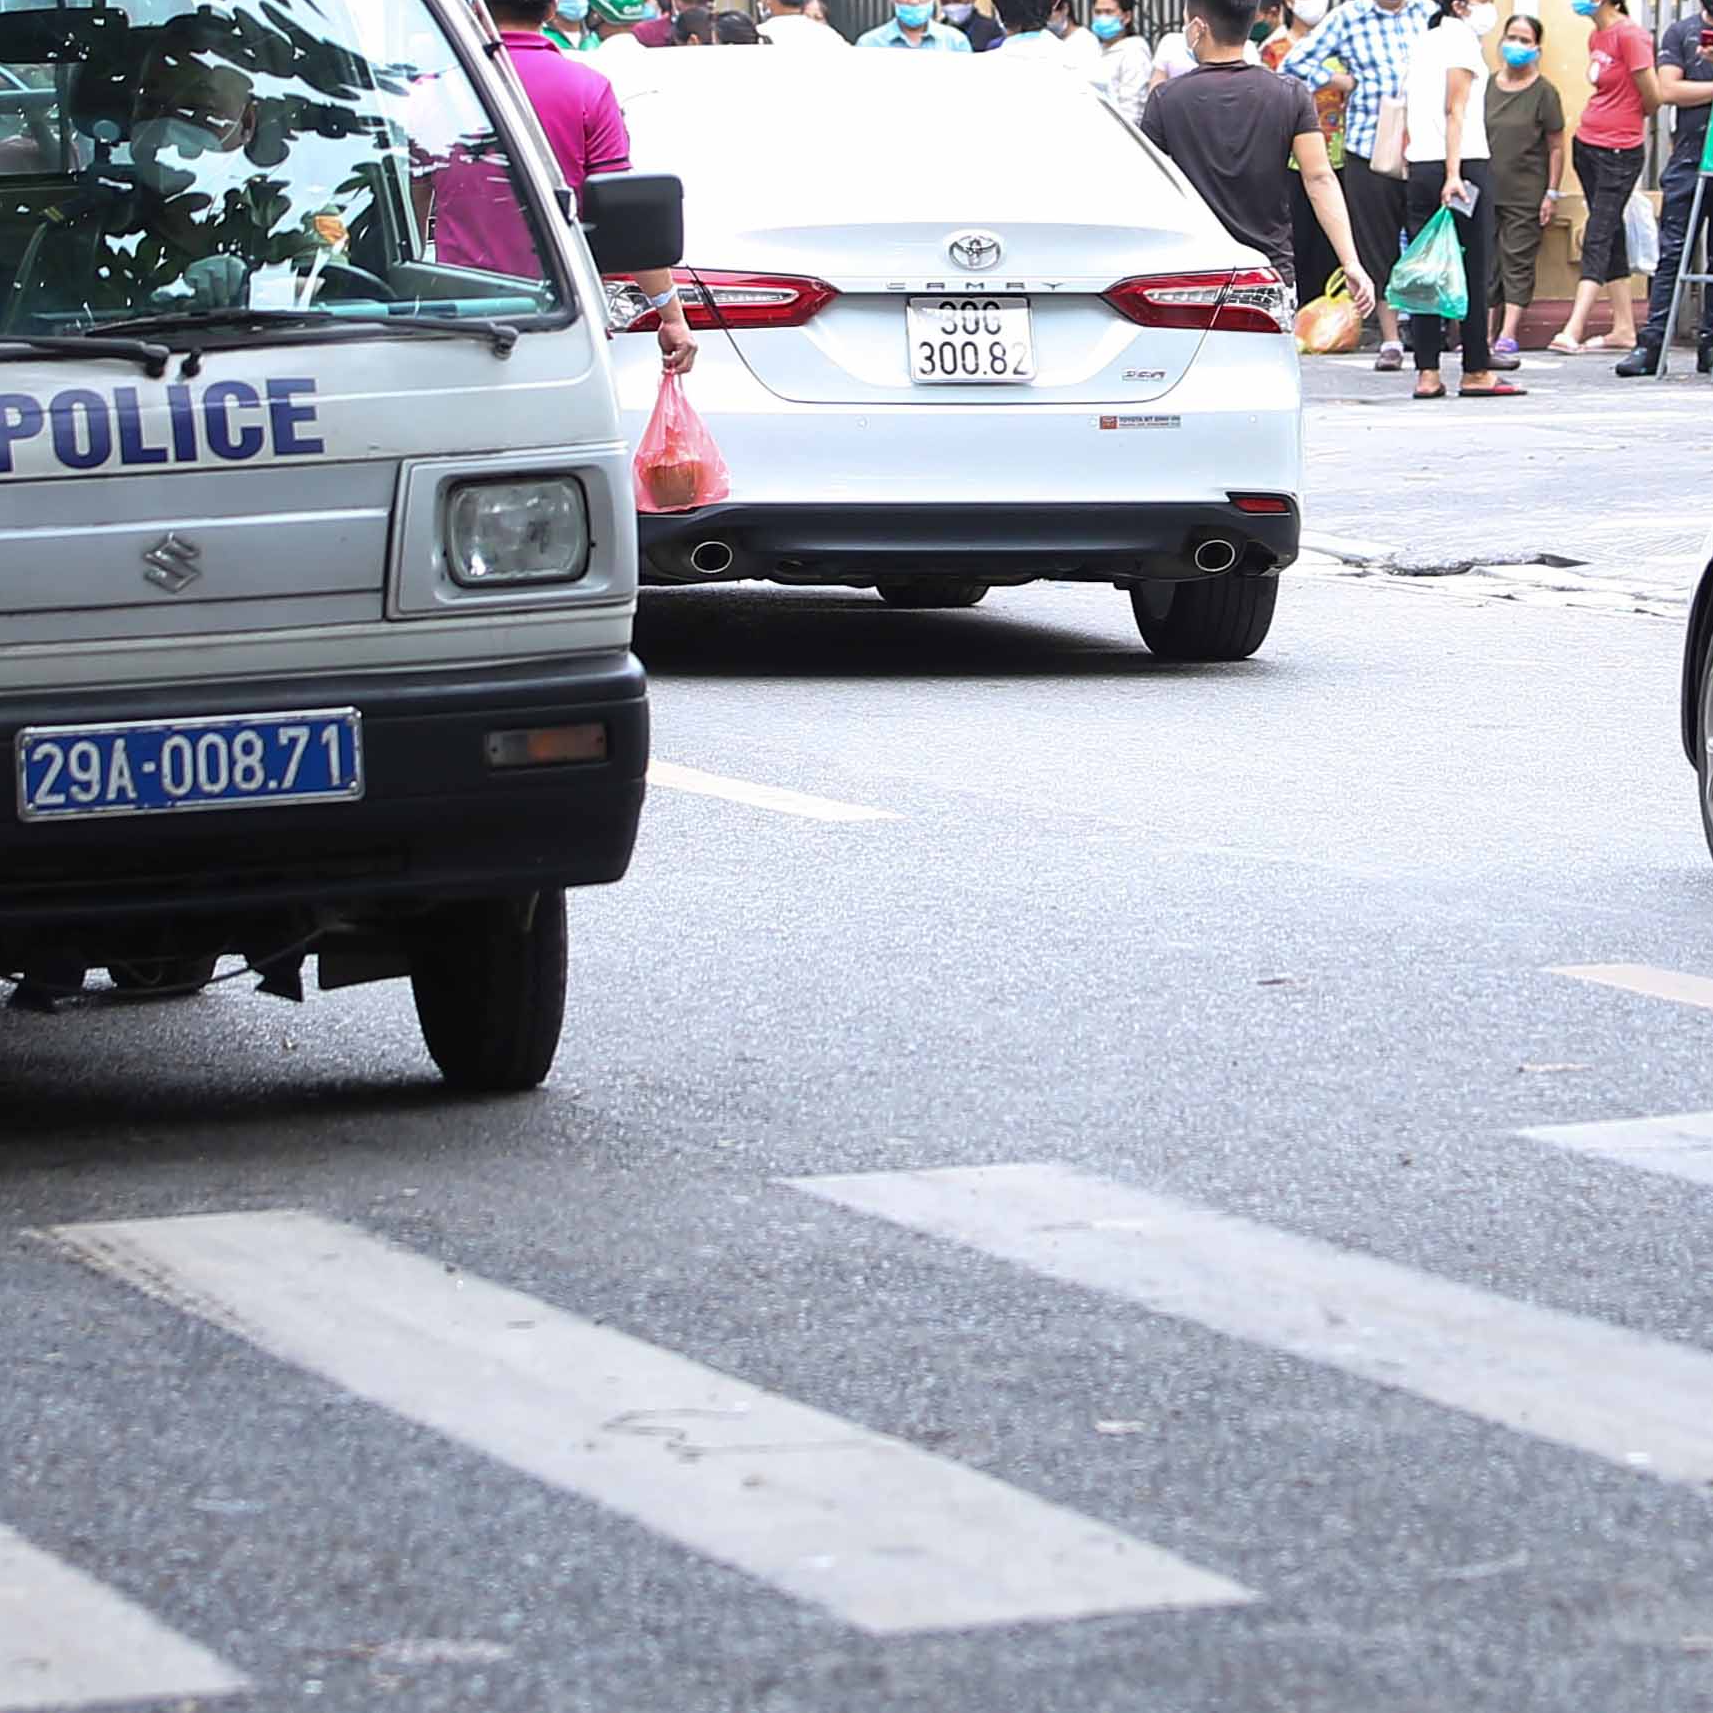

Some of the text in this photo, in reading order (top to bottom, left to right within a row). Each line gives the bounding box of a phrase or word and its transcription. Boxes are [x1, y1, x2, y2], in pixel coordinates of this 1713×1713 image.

[886, 282, 1064, 291] CAMRY
[918, 341, 1030, 376] 300.82
[32, 724, 341, 806] 29A-008.71
